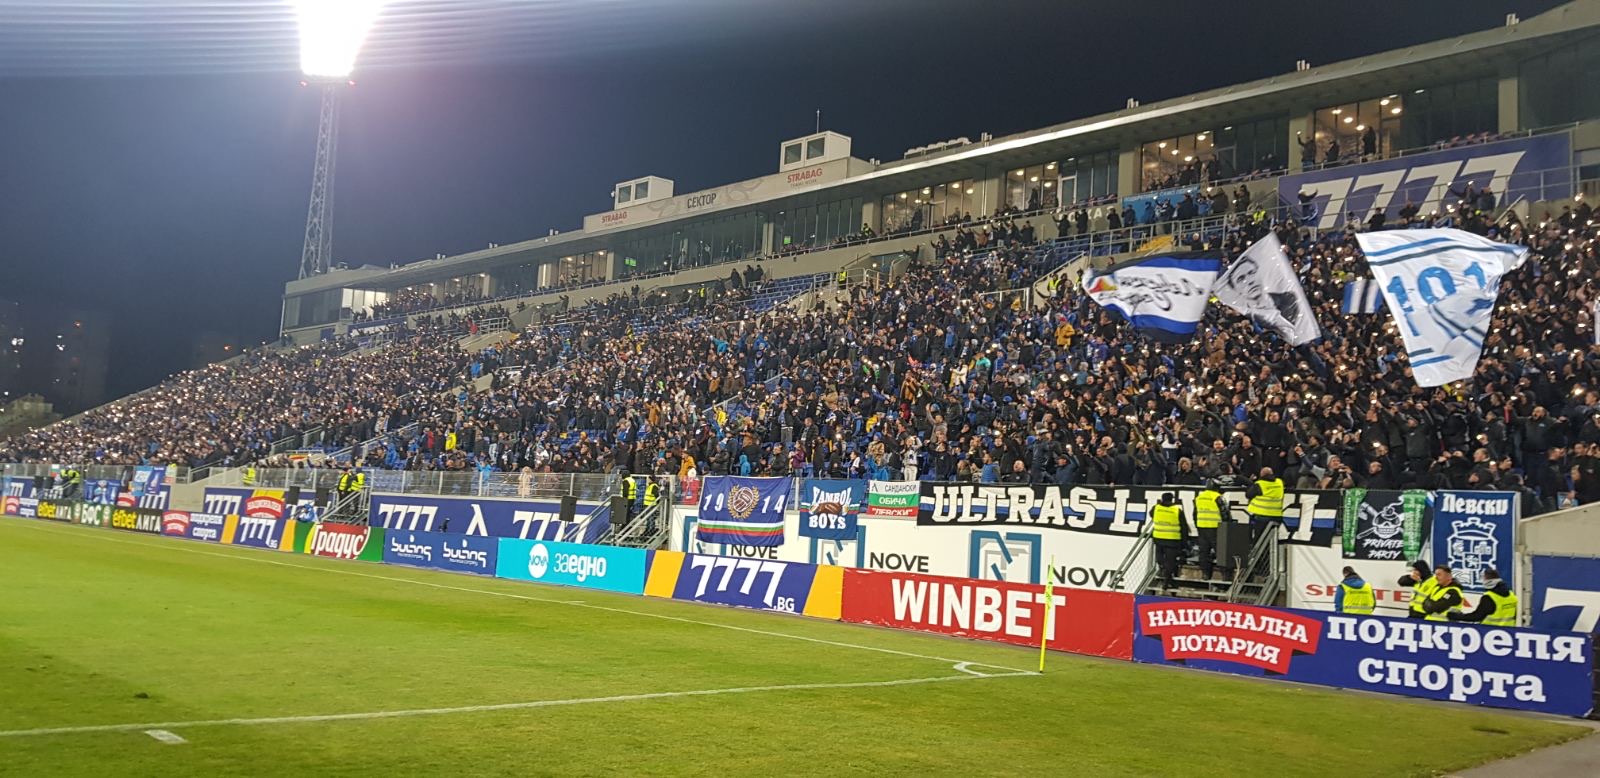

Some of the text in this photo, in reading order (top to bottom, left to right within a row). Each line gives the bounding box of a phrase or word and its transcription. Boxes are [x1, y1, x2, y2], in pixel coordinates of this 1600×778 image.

[787, 168, 823, 183] STRABAG
[1301, 151, 1526, 229] 7777
[601, 211, 628, 224] STRABAG
[811, 486, 852, 506] YAMBOL
[884, 482, 917, 493] САНДАНСКИ
[878, 496, 907, 505] ОБИЧА
[931, 485, 1097, 529] ULTRAS
[378, 503, 439, 532] 7777
[808, 513, 847, 530] BOYS
[731, 545, 778, 559] NOVE
[1362, 538, 1404, 549] PRIVATE
[869, 551, 929, 572] NOVE
[1367, 550, 1402, 559] PARTY
[891, 578, 1066, 641] WINBET
[1147, 608, 1308, 644] НАЦИОНАЛНА
[1171, 634, 1281, 665] ЛОТАРИЯ
[1327, 615, 1586, 664] подкрепя
[1358, 657, 1546, 702] спорта
